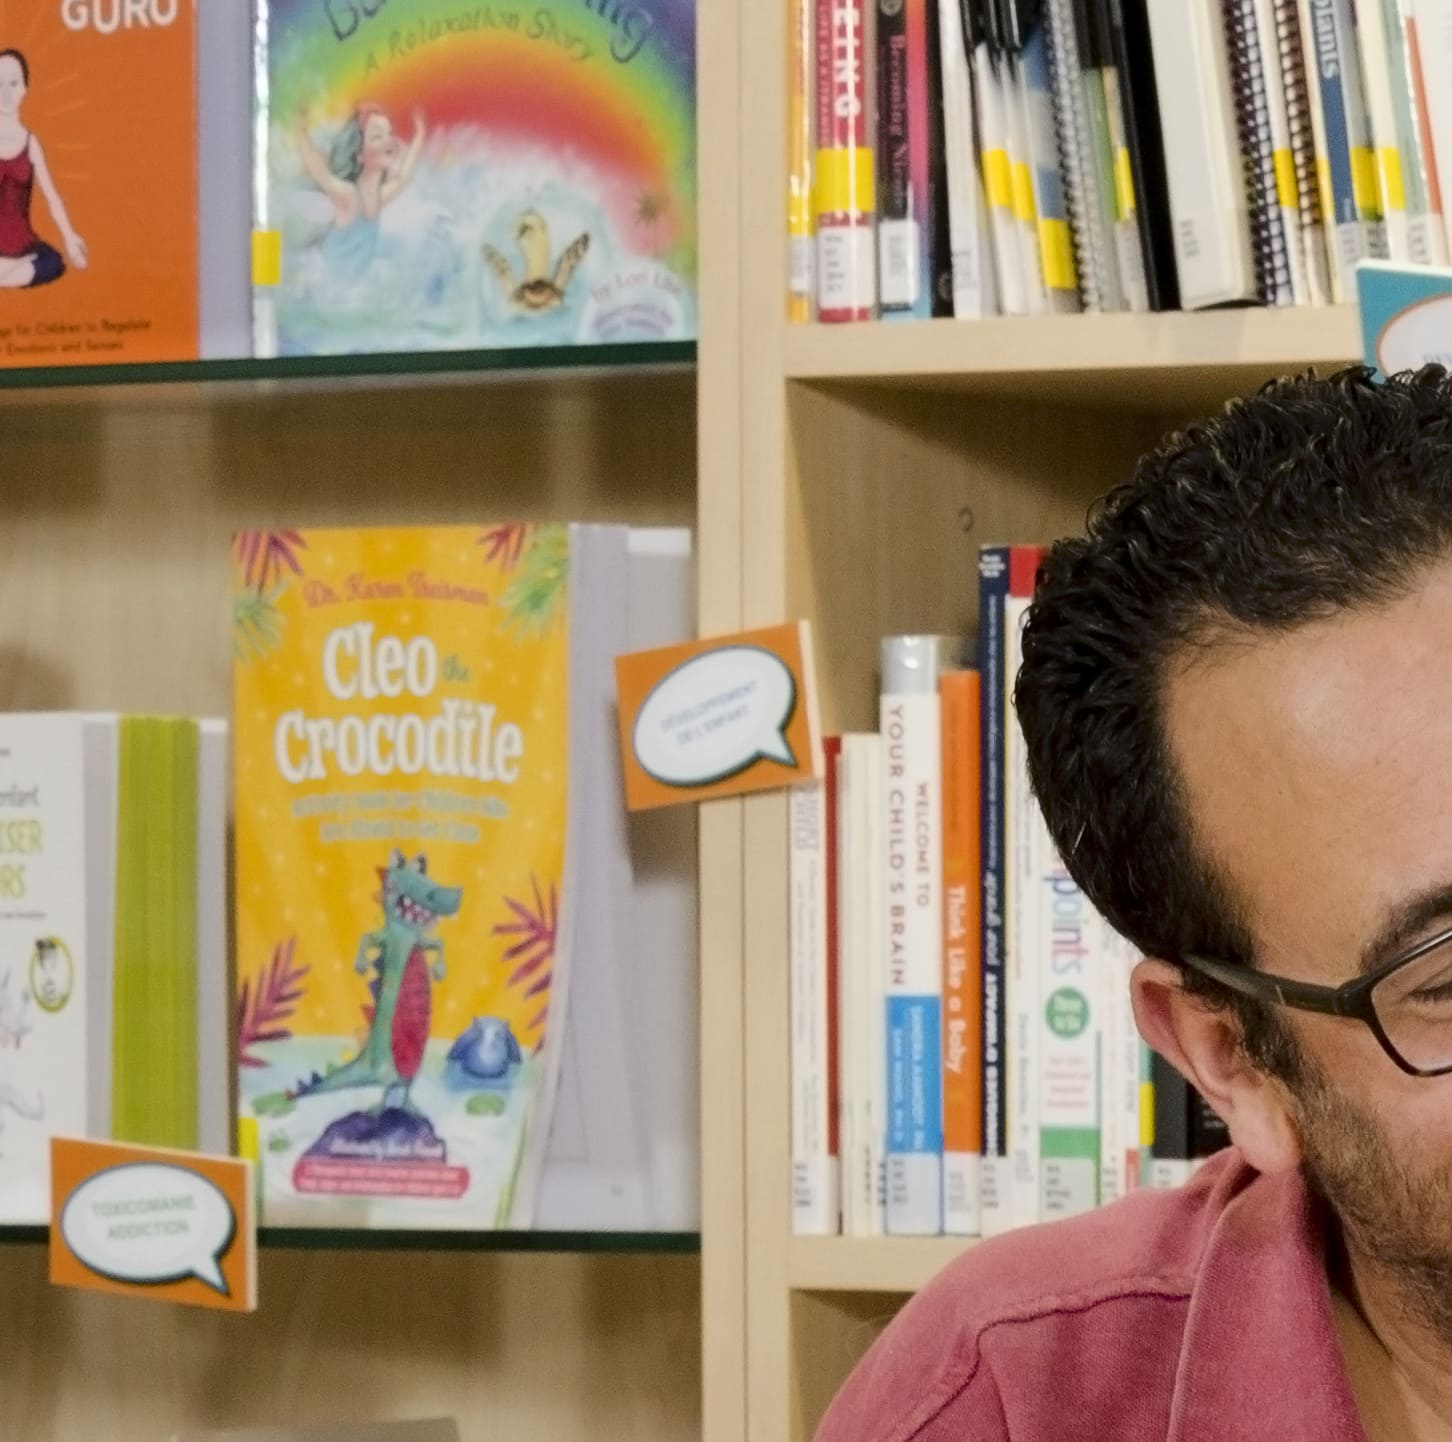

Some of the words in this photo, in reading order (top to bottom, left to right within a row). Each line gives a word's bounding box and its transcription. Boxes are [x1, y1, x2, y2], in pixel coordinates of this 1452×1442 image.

[322, 620, 438, 700] Cleo
[273, 697, 524, 784] Crocodile
[887, 704, 905, 779] YOUR
[887, 789, 905, 899] CHILD'S
[914, 782, 930, 879] WELCOME
[914, 886, 930, 908] TO
[945, 884, 968, 949] Think
[887, 905, 905, 985] BRAIN
[945, 951, 966, 993] Like
[948, 998, 963, 1011] a
[941, 1019, 966, 1076] Baby
